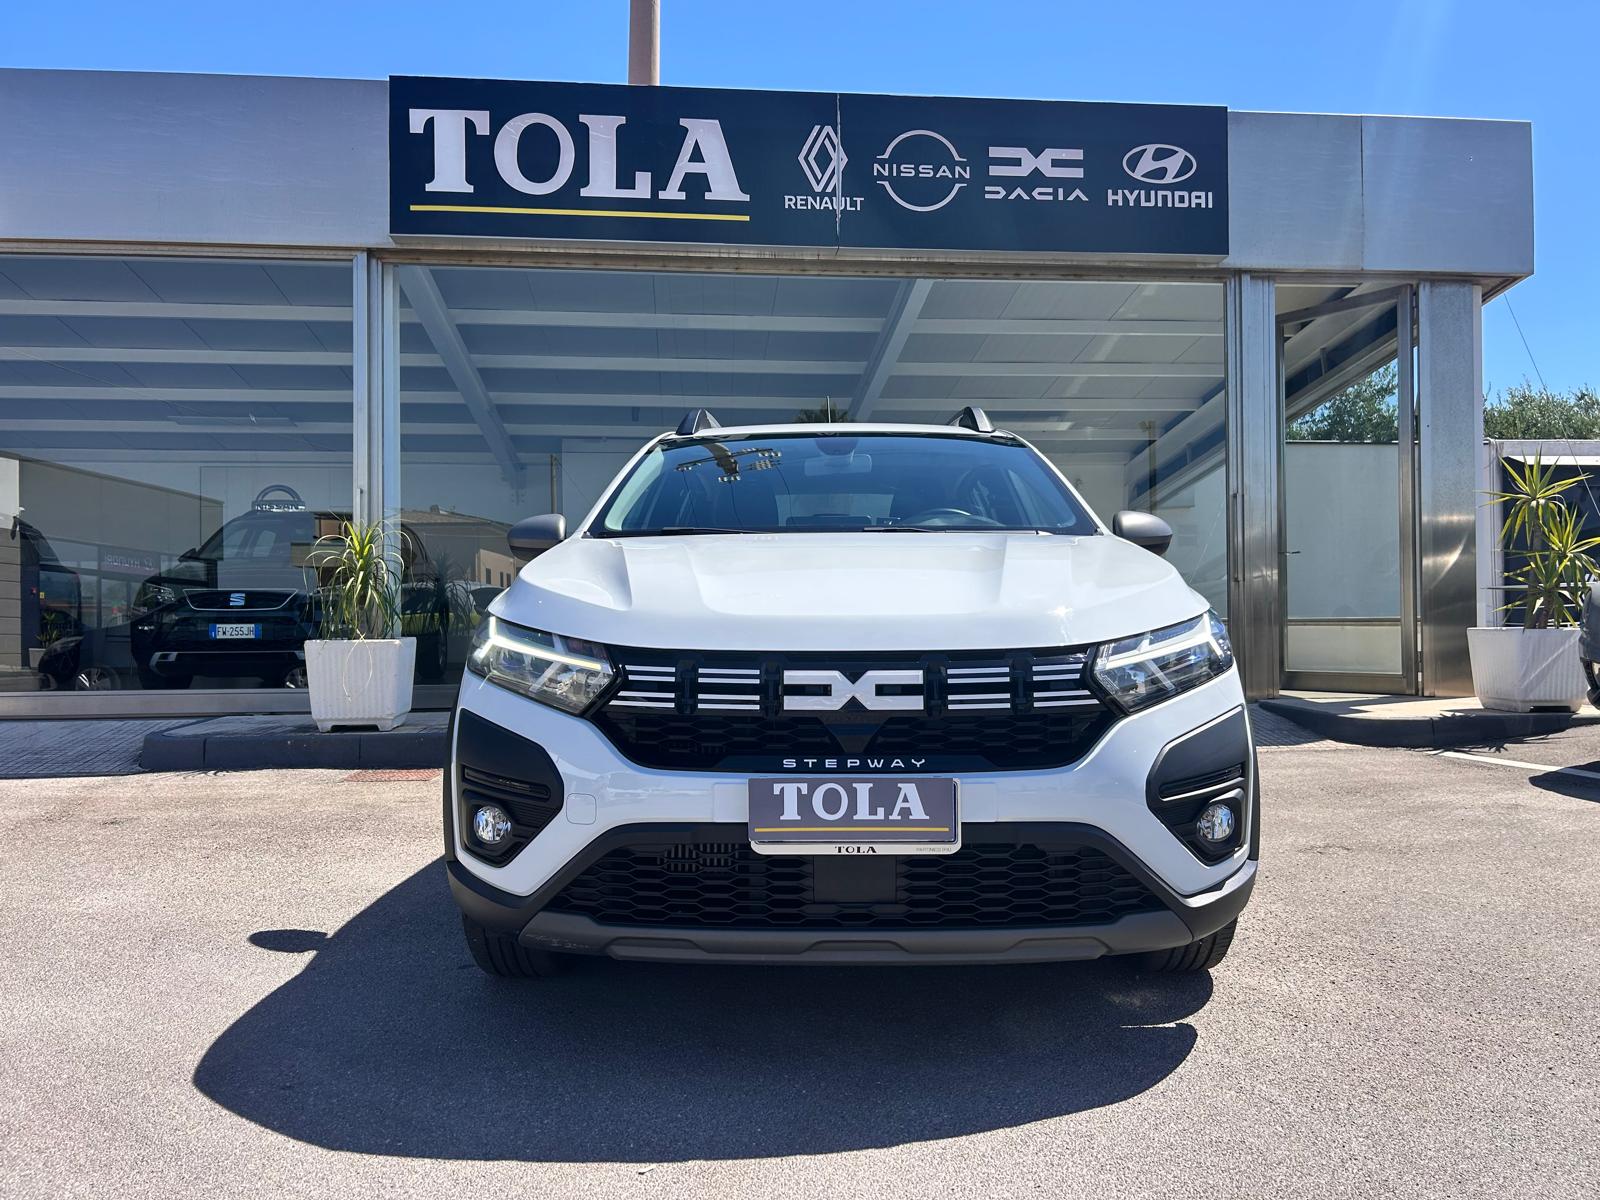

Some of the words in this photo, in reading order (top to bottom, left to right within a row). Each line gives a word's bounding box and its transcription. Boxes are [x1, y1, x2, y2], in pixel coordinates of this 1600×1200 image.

[409, 108, 750, 202] TOLA
[873, 163, 970, 179] NISSAN
[984, 186, 1089, 201] DACIA
[1107, 189, 1213, 209] HYUNDAI
[784, 195, 865, 211] RENAULT
[782, 758, 926, 768] STEPWAY
[773, 782, 930, 821] TOLA
[834, 846, 877, 854] TOLA
